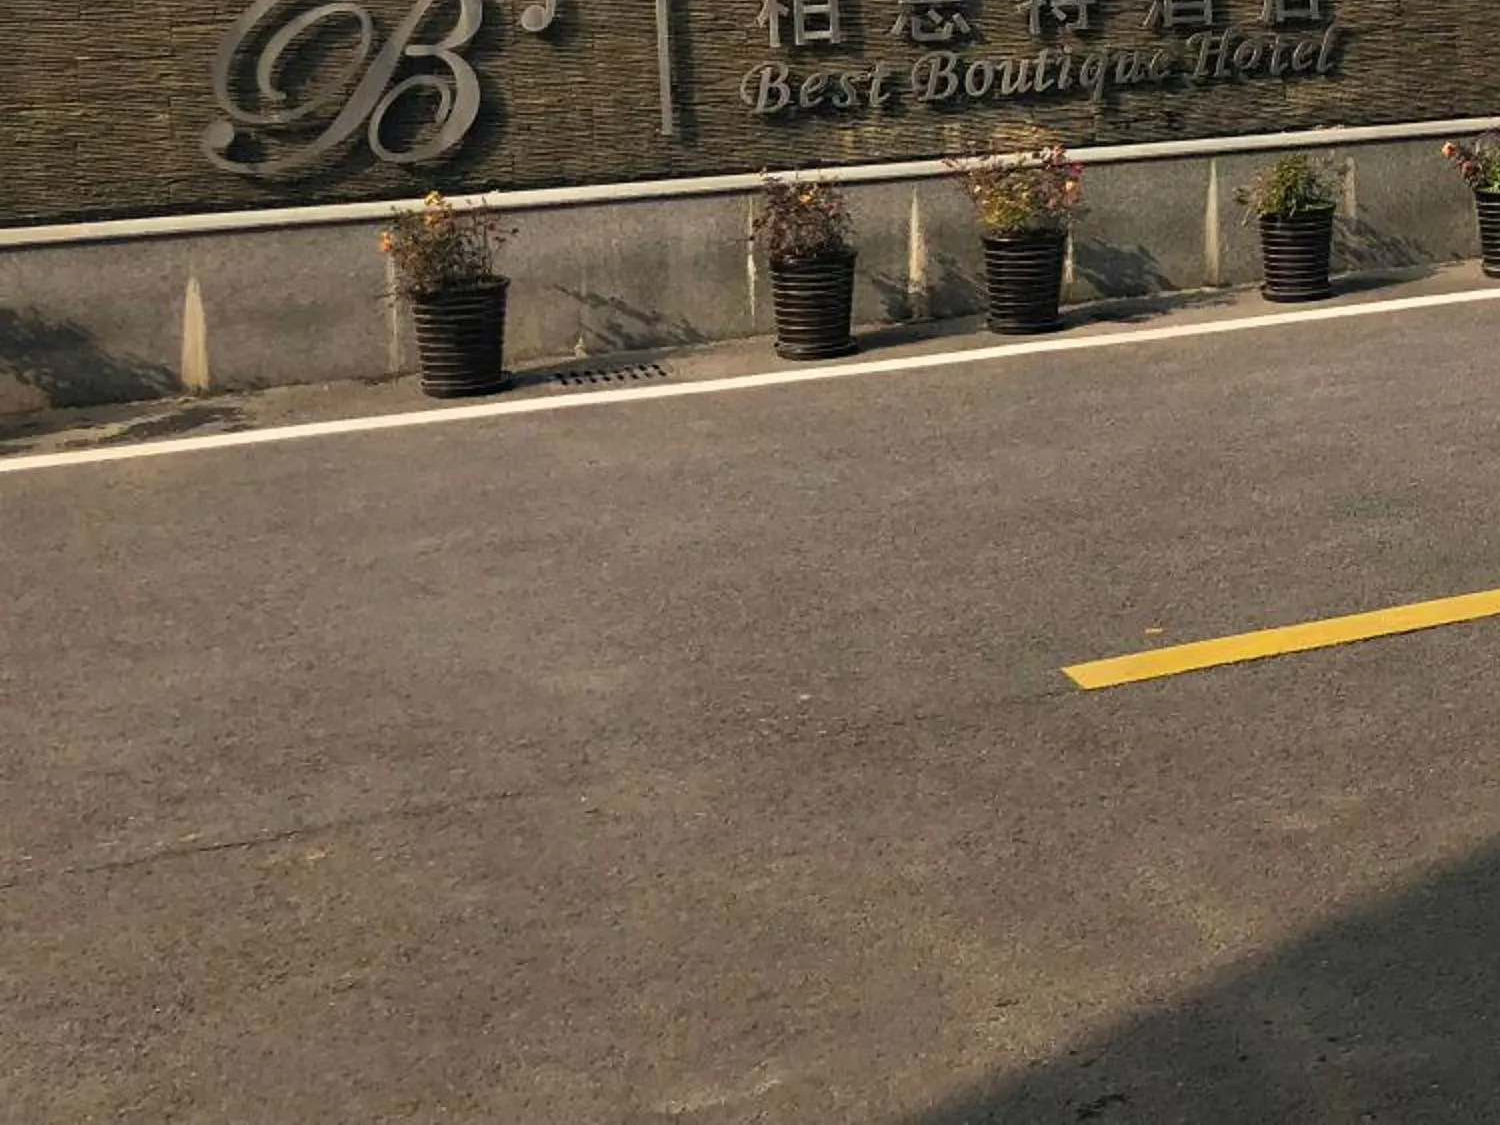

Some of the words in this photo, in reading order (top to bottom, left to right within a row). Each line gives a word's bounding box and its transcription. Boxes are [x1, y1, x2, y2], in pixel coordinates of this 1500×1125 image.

[739, 58, 892, 114] Best
[909, 40, 1173, 103] Boutique
[1186, 24, 1338, 79] Hotel
